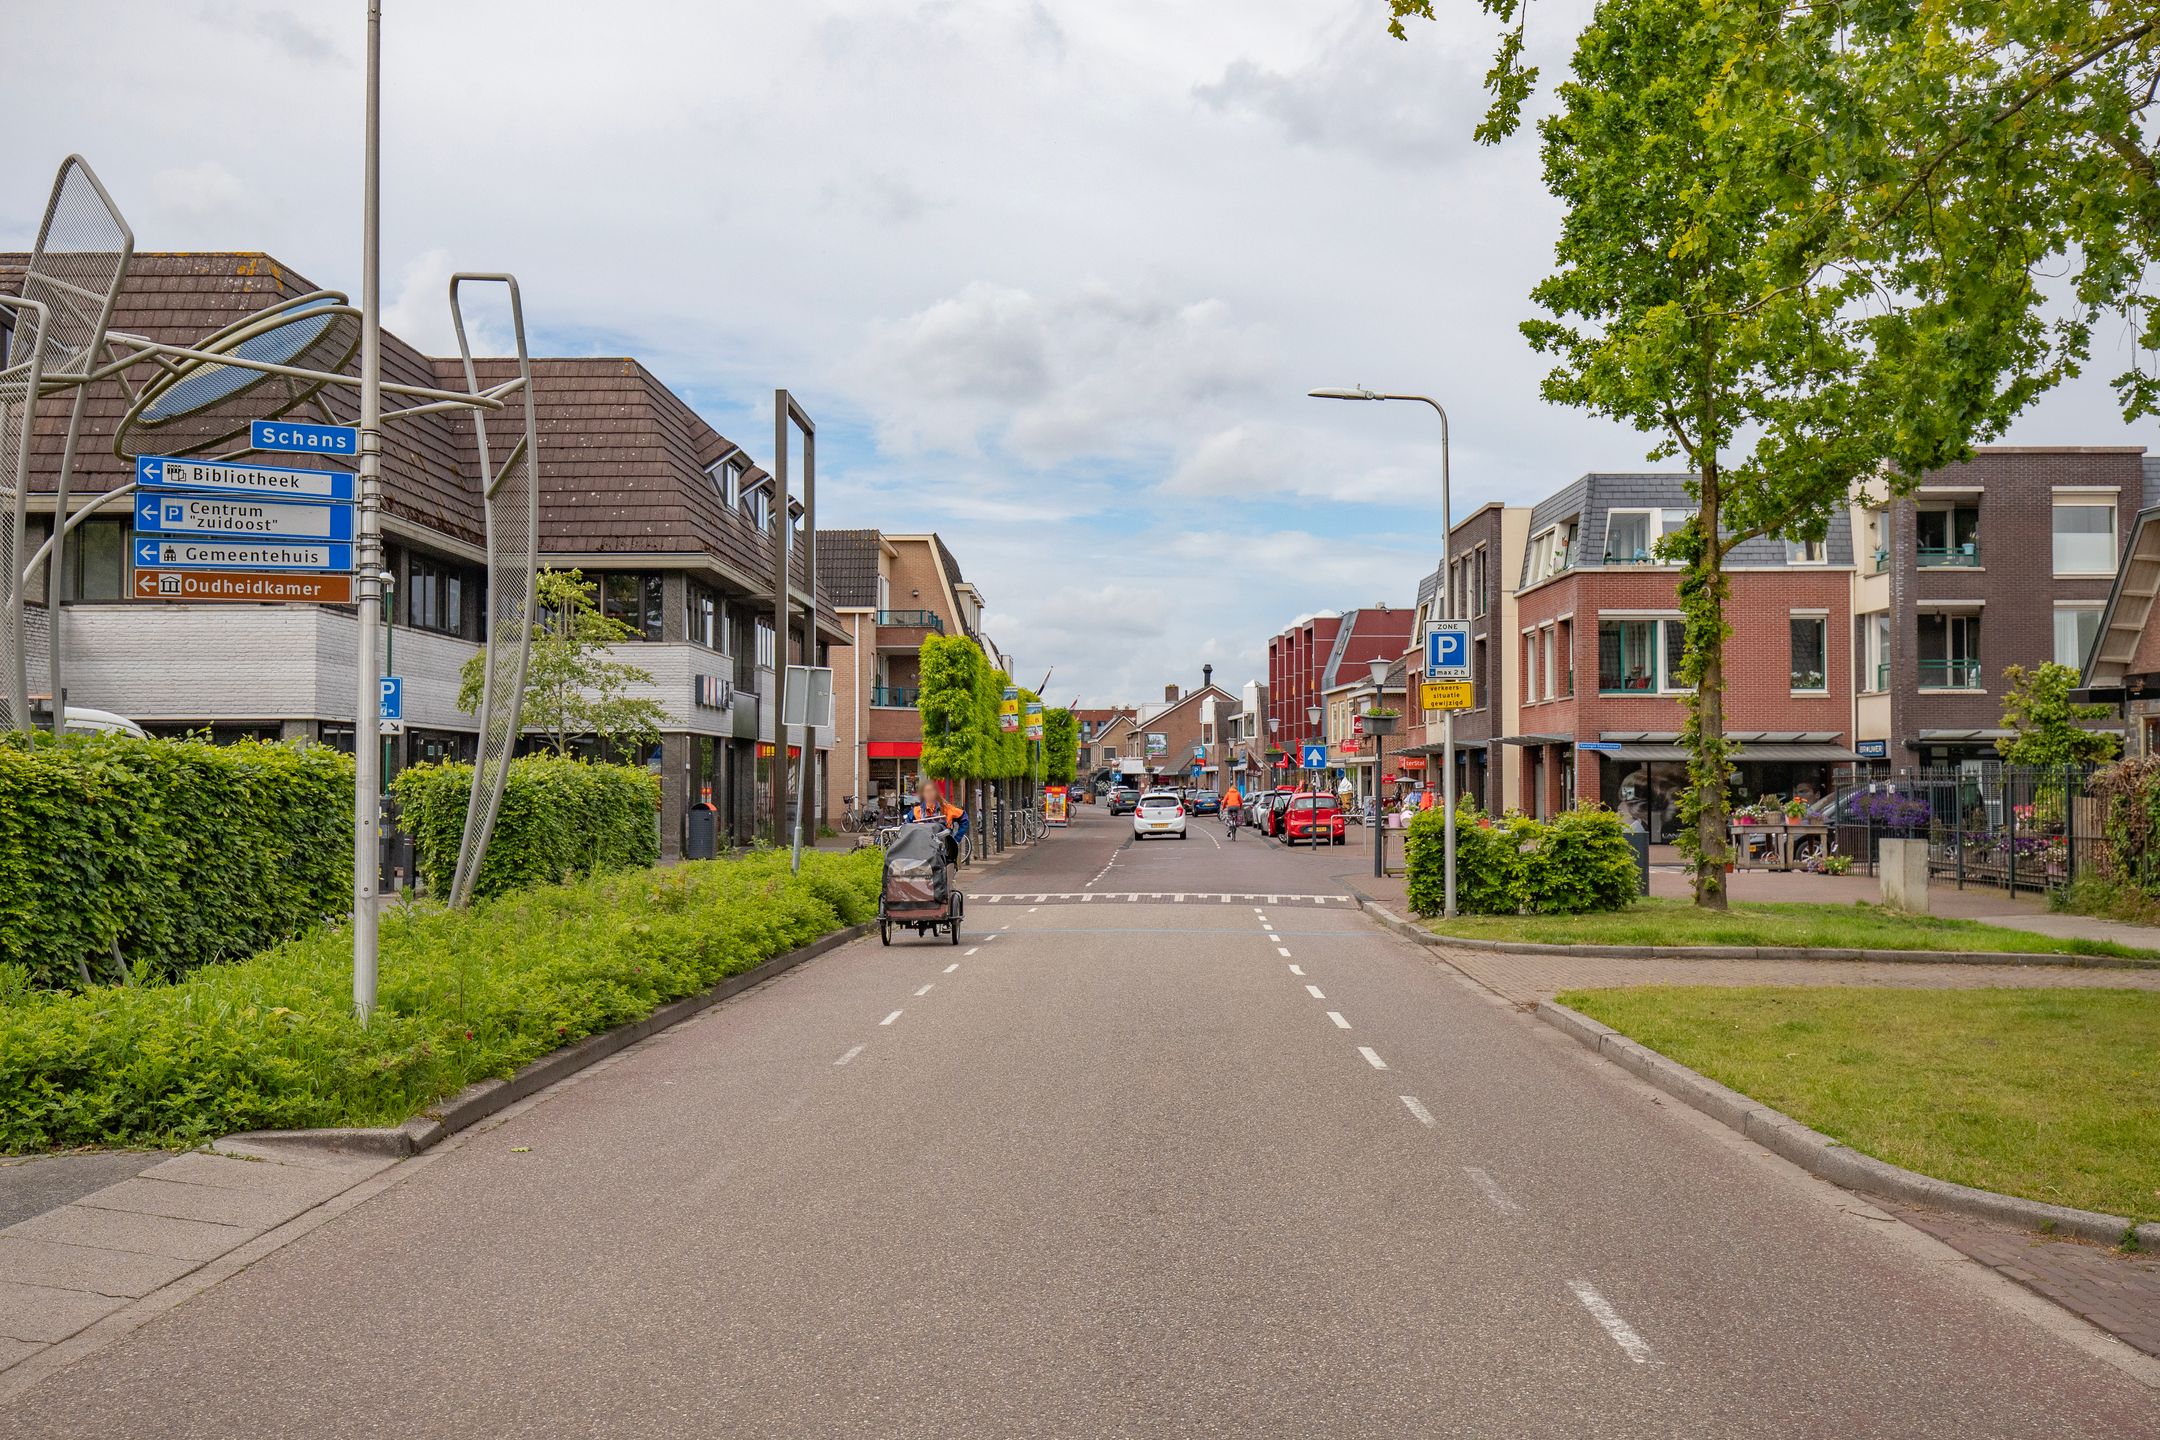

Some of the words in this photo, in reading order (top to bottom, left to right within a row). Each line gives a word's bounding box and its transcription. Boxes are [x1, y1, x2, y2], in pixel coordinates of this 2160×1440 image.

[262, 427, 347, 449] Schans
[193, 467, 300, 489] Bibliotheek
[168, 507, 180, 520] P
[190, 501, 263, 517] Centrum
[189, 515, 278, 532] "zuidoost"
[185, 546, 319, 564] Gemeentehuis
[184, 578, 322, 596] Oudheidkamer
[1438, 636, 1458, 663] P
[380, 681, 396, 702] P
